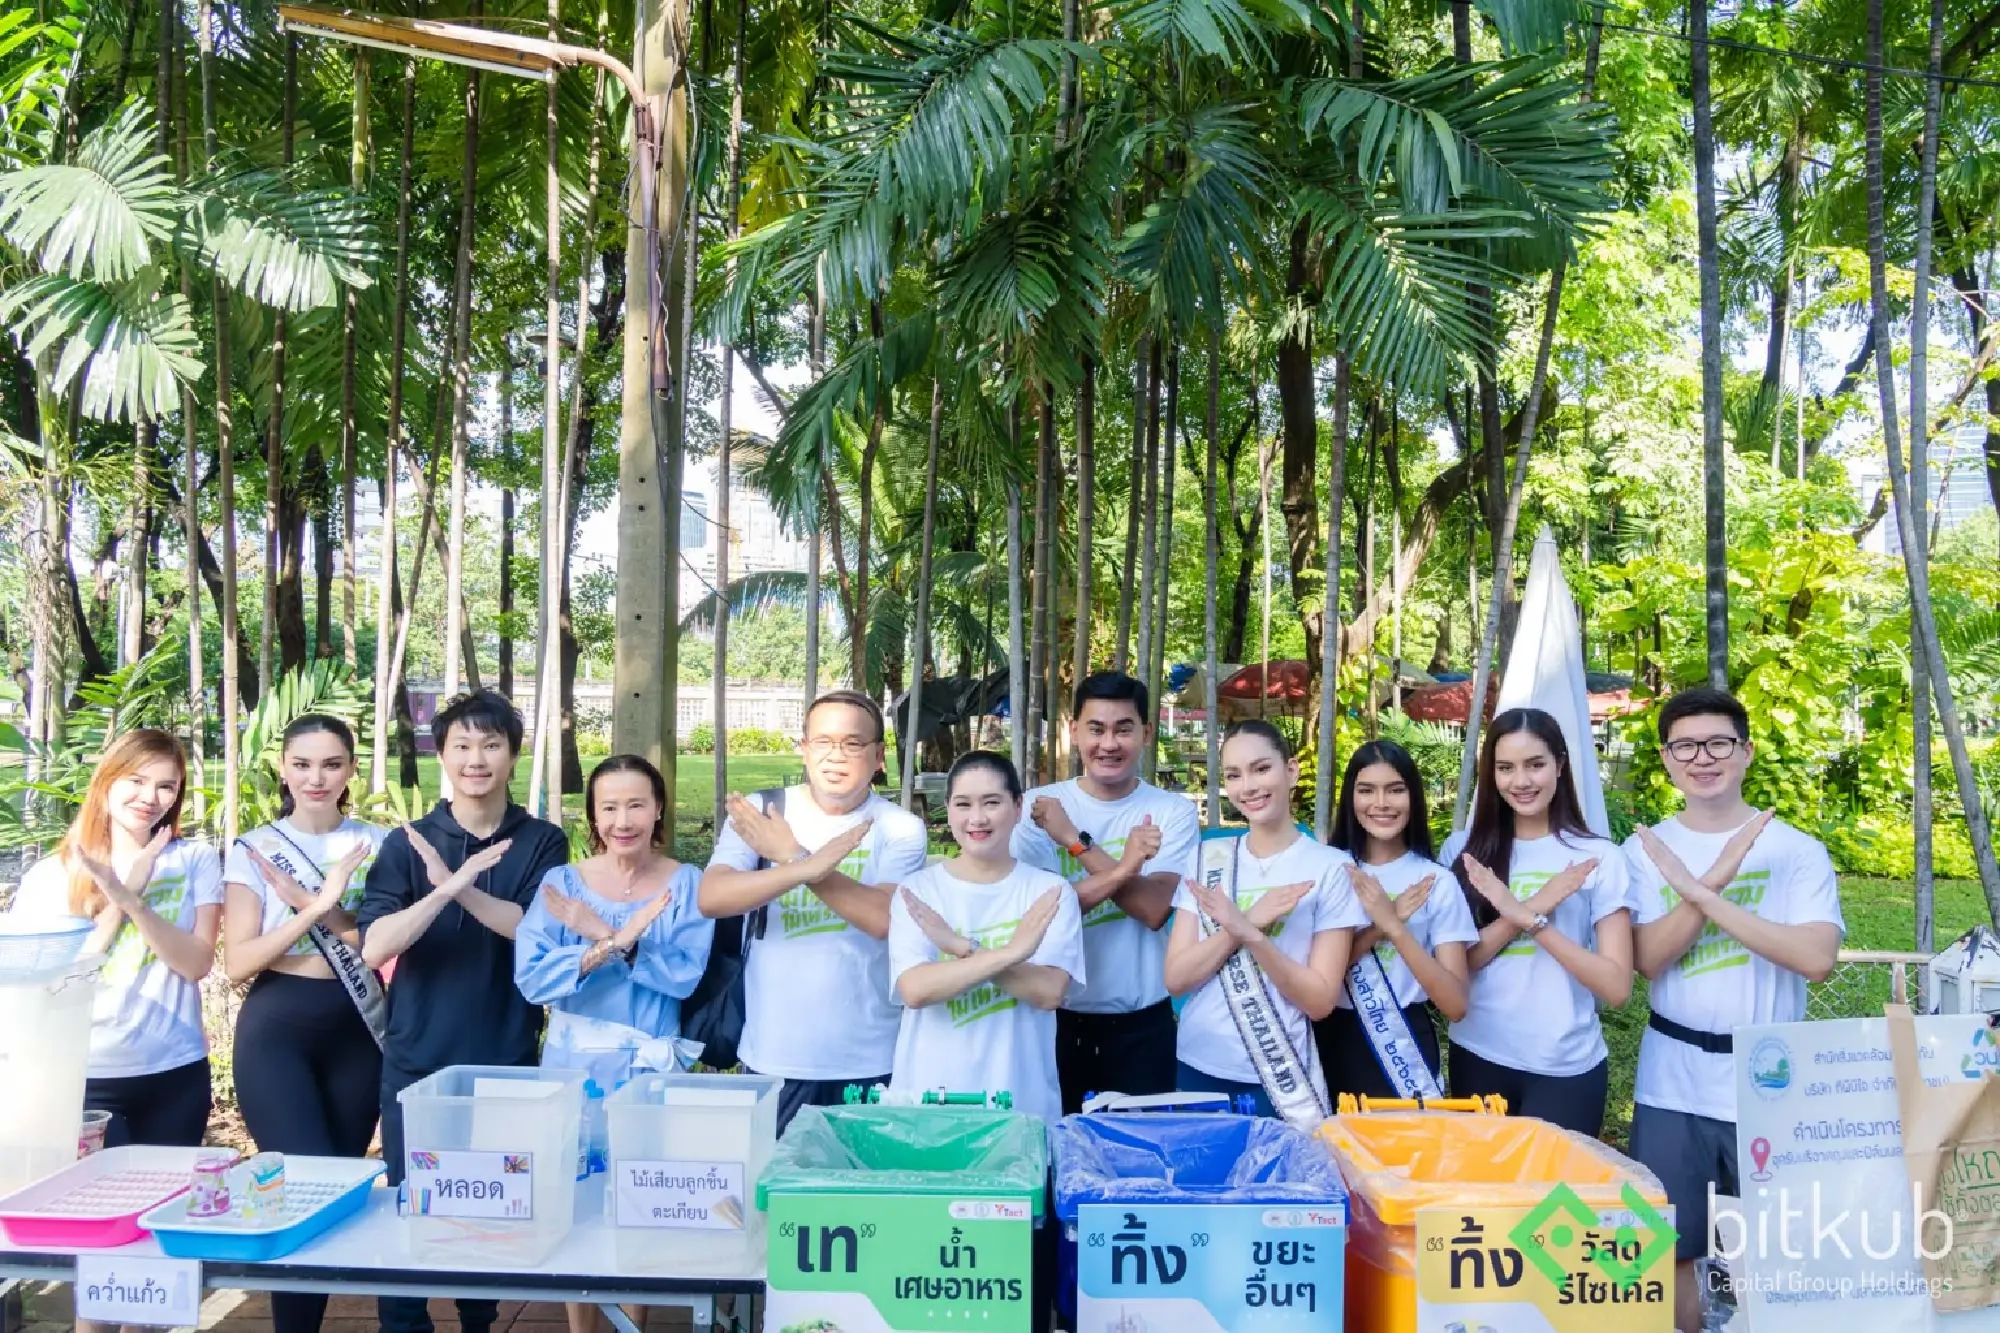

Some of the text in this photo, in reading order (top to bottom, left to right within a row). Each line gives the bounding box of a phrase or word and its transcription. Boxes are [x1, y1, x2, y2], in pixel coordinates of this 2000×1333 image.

[331, 939, 368, 999] THAILAND
[1351, 963, 1389, 1034] างสาวไทย
[1241, 997, 1297, 1095] THAILAND
[435, 1178, 505, 1200] หลอด
[630, 1166, 729, 1195] ไม้เสียบลูกชิ้น
[652, 1203, 709, 1221] ตะเกียบ
[939, 1227, 976, 1269] น้ำ
[1252, 1241, 1316, 1265] ขยะ
[1581, 1231, 1642, 1271] วัสดุ
[87, 1271, 168, 1305] คว่ำแก้ว
[895, 1276, 1023, 1301] เศษอาหาร
[1245, 1268, 1316, 1312] อื่นๆ
[1558, 1272, 1664, 1304] รีไซเคิล
